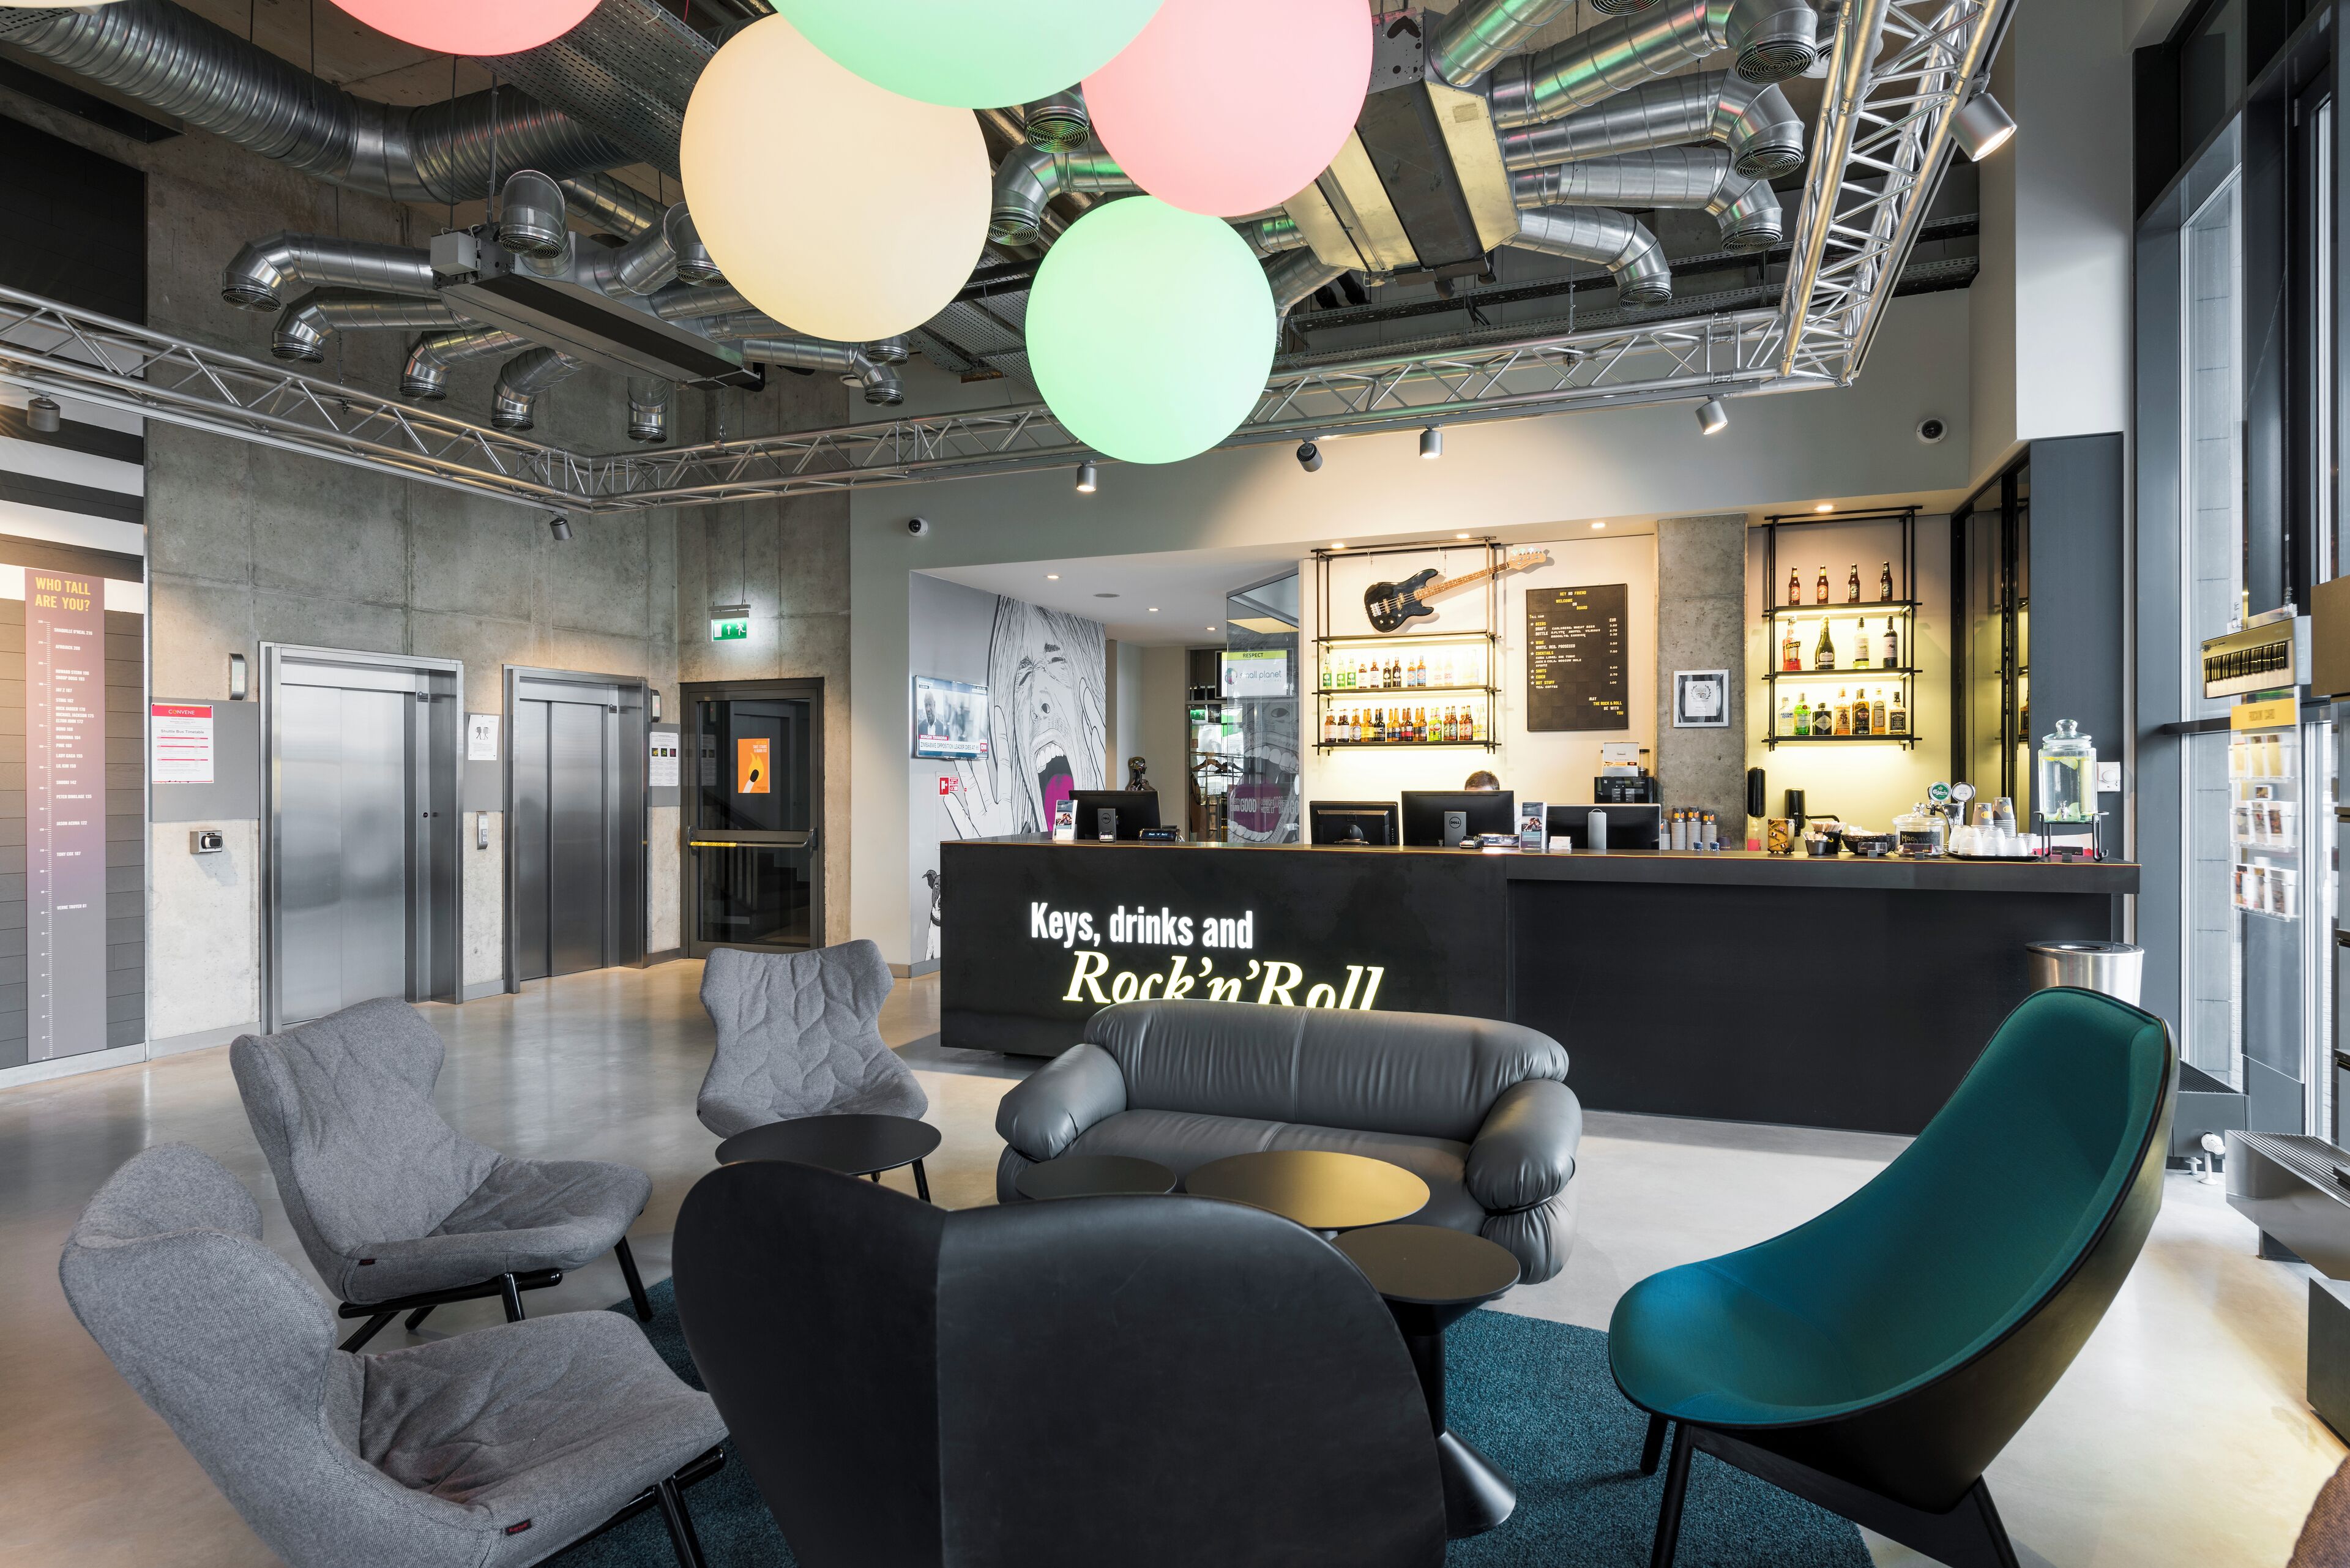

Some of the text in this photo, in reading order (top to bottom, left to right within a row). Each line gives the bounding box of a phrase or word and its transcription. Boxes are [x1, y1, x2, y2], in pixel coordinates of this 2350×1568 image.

[35, 577, 91, 595] WHO TALL
[35, 594, 90, 611] ARE YOU?
[1259, 670, 1281, 680] planet
[1240, 798, 1257, 813] GOOD
[1031, 902, 1253, 949] Keys, drinks and
[1062, 950, 1384, 1010] Rock'n'Roll
